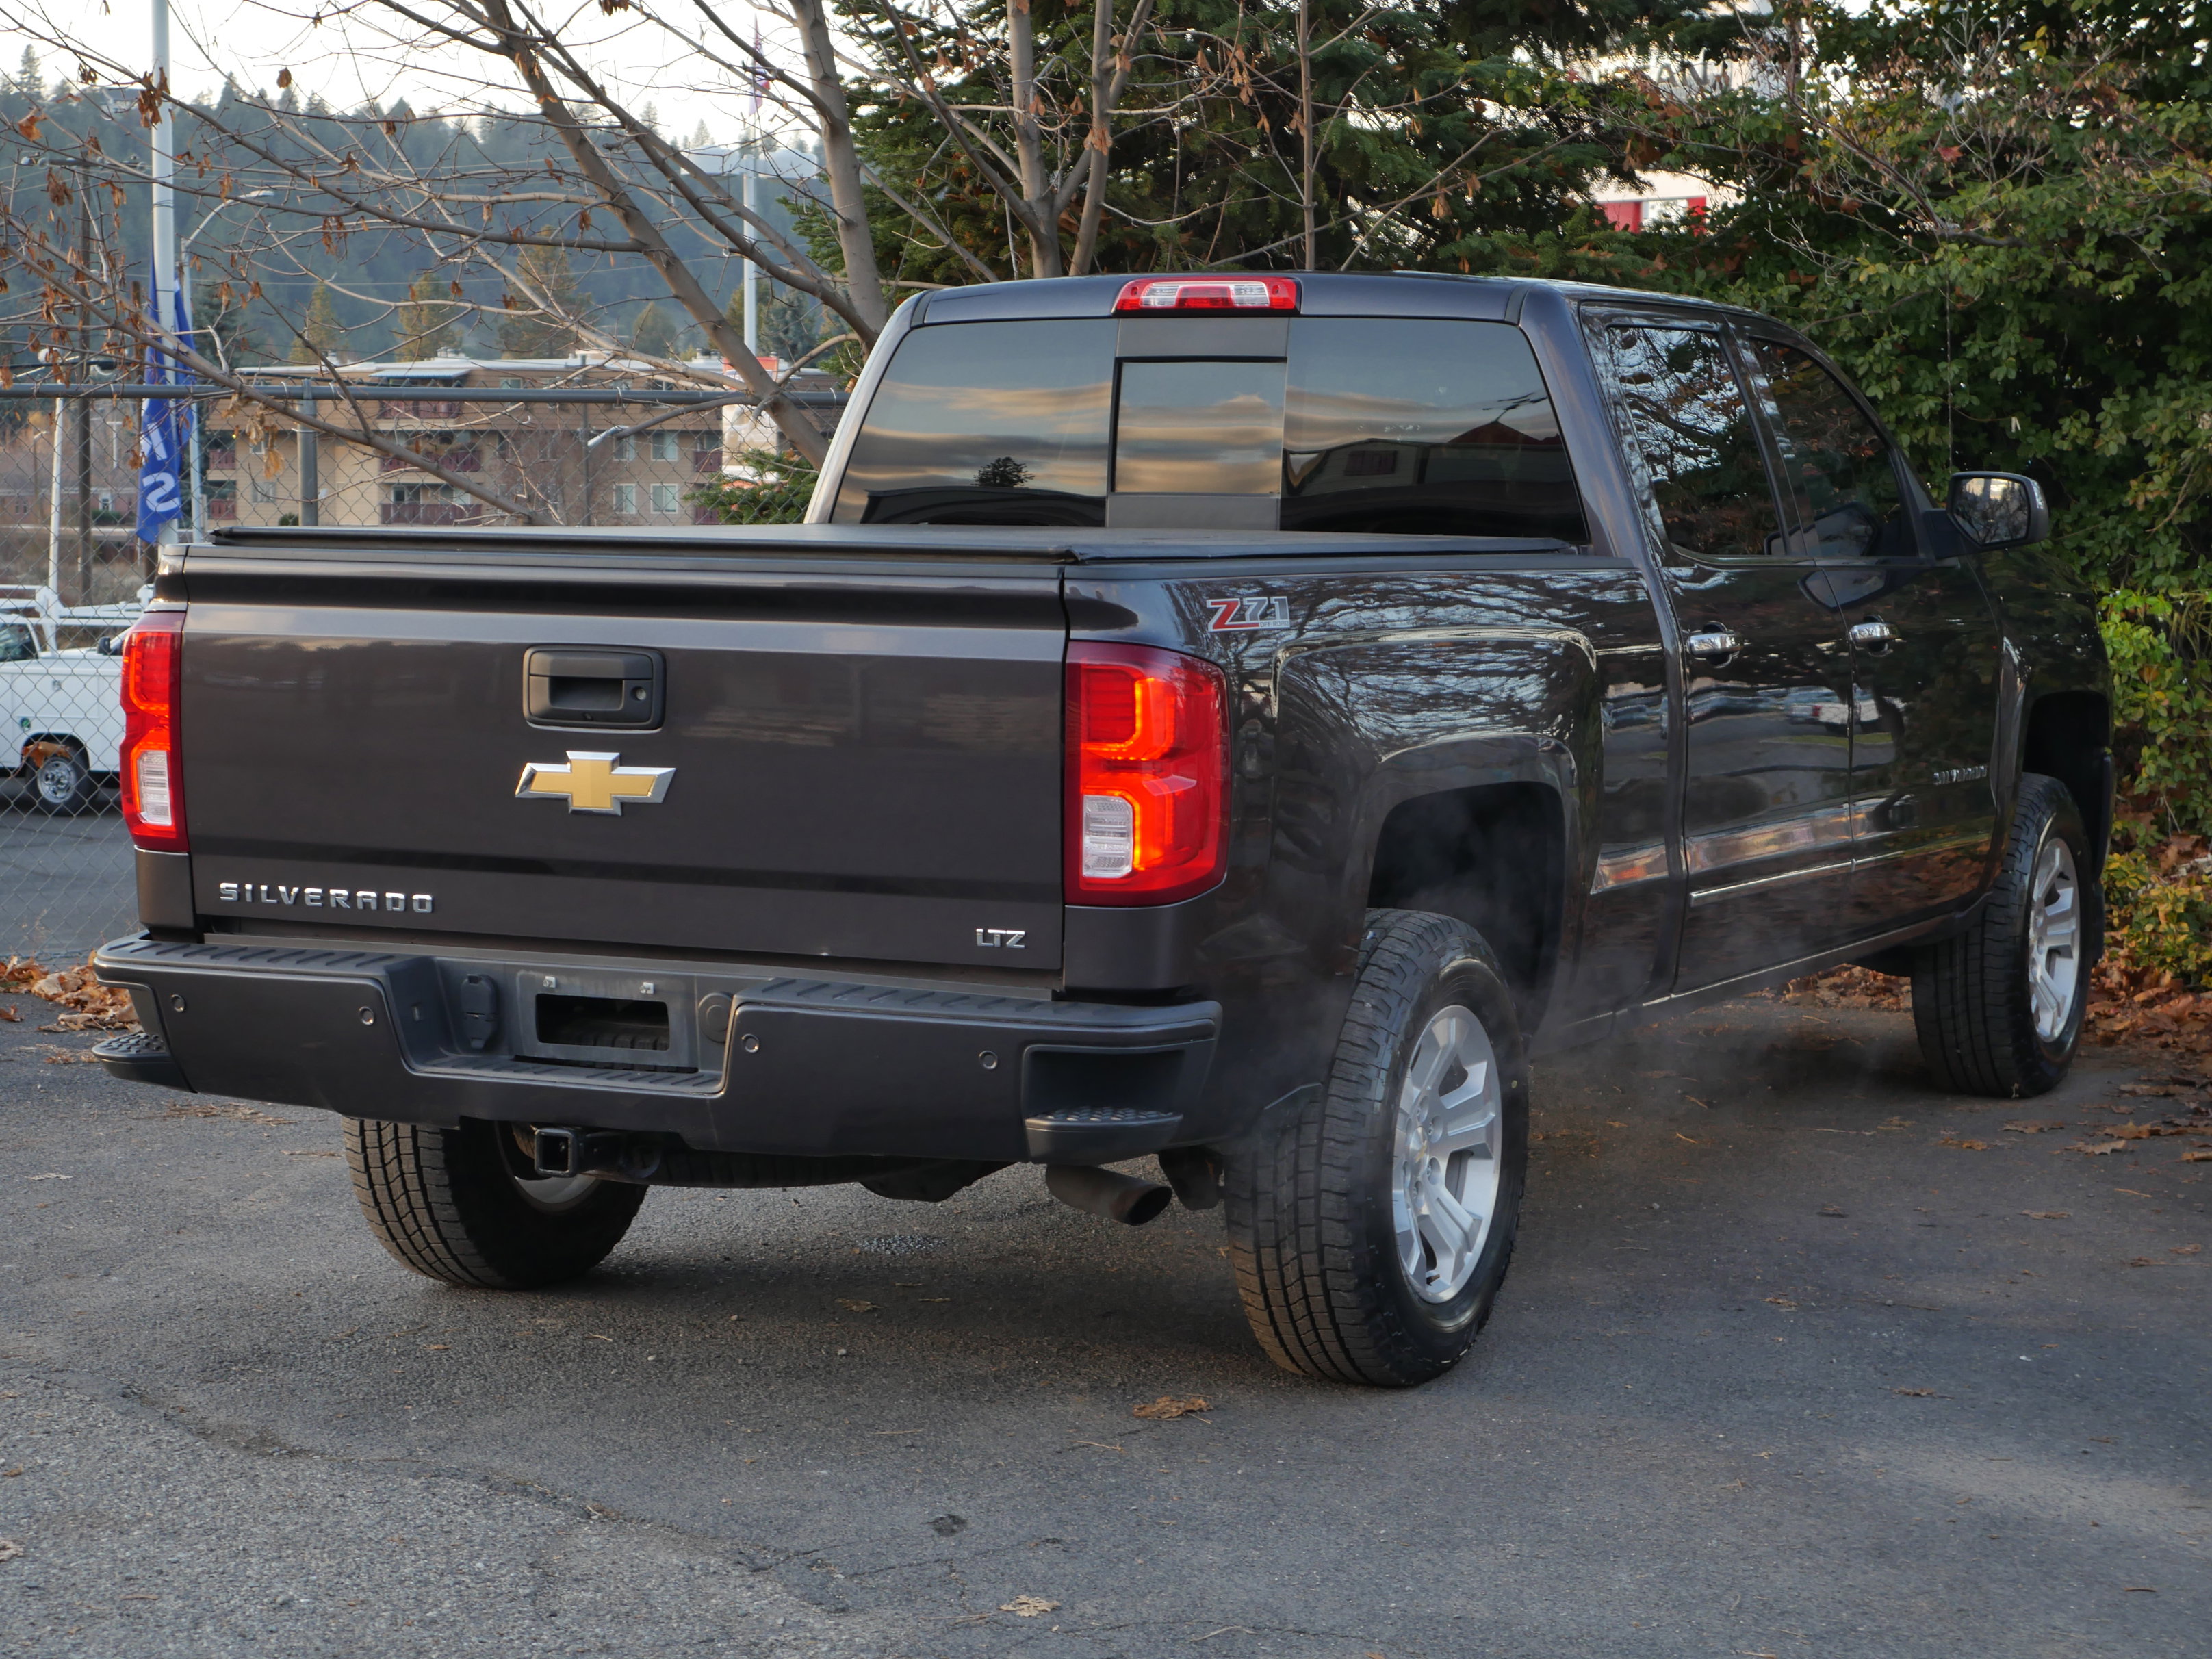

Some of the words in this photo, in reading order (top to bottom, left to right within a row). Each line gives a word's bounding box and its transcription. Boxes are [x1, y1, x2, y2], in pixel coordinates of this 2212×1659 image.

[1207, 596, 1289, 632] Z71
[219, 883, 433, 913] SILVERADO
[976, 928, 1025, 949] LTZ
